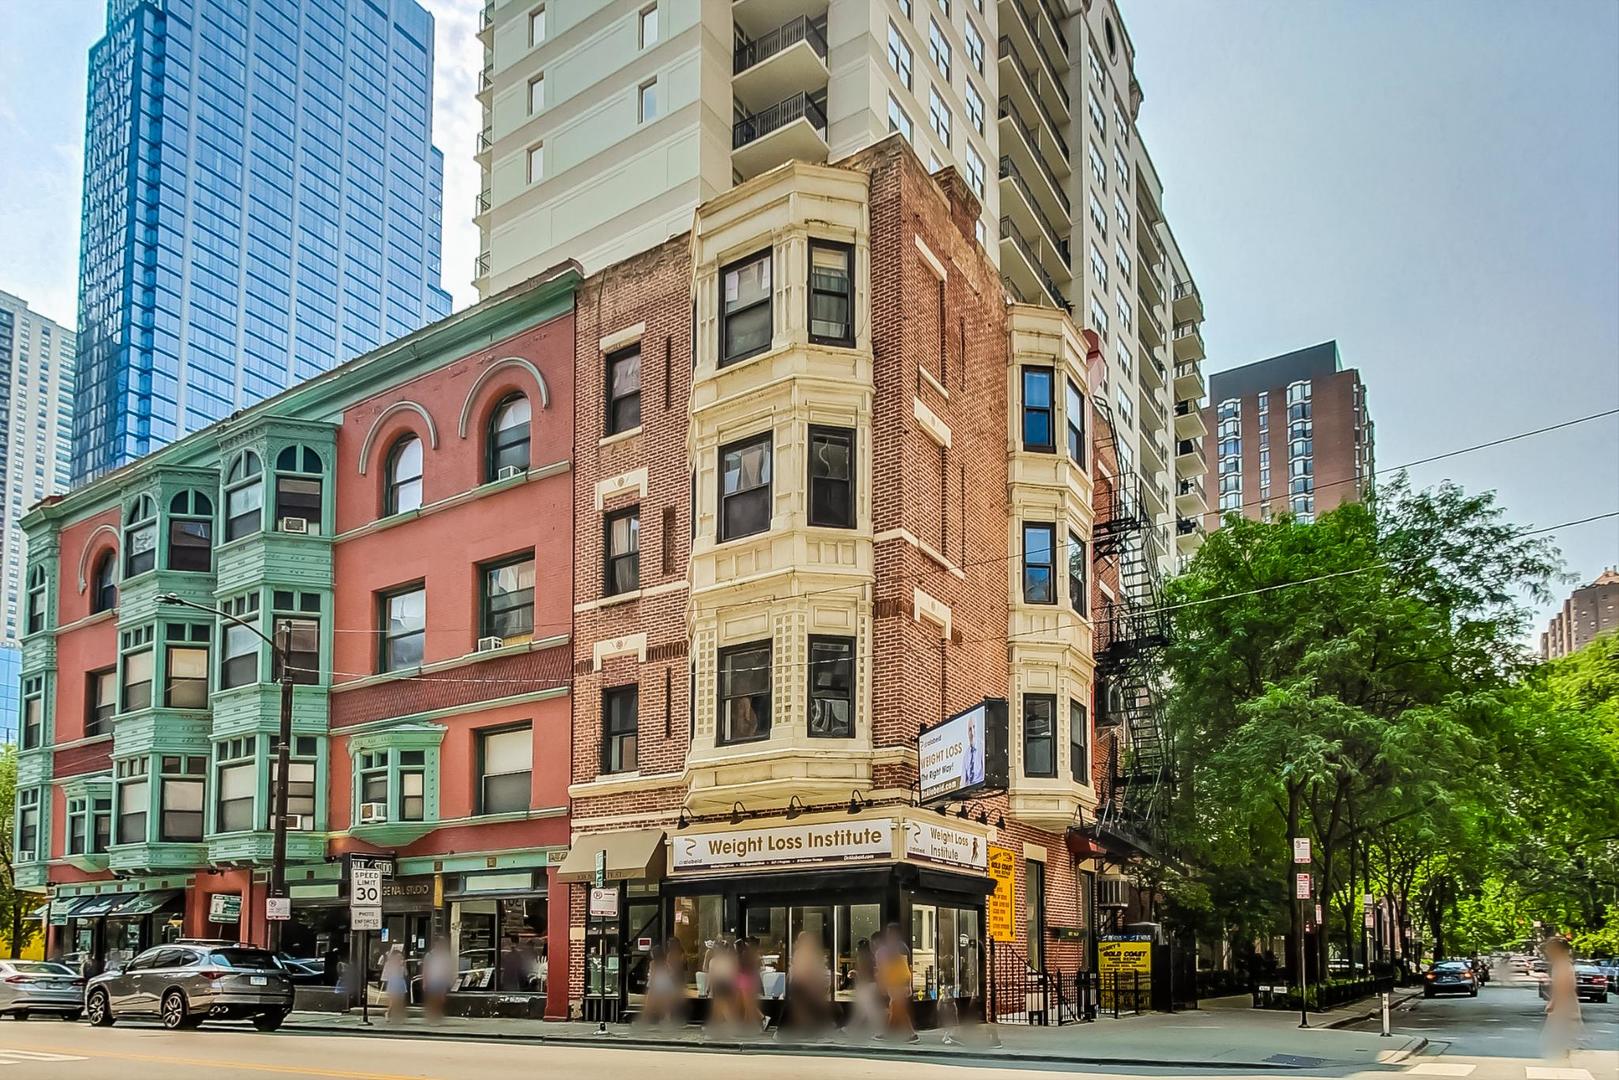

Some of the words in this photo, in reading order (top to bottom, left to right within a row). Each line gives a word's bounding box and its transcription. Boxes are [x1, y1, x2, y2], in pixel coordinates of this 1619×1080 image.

[921, 750, 944, 769] WEIGHT
[945, 742, 963, 758] LOSS
[929, 767, 941, 780] Right
[708, 835, 763, 857] Weight
[768, 835, 802, 851] Loss
[808, 828, 882, 848] Institute
[930, 827, 954, 844] Weight
[955, 833, 969, 847] Loss
[930, 844, 959, 860] Institute
[356, 887, 378, 901] 30
